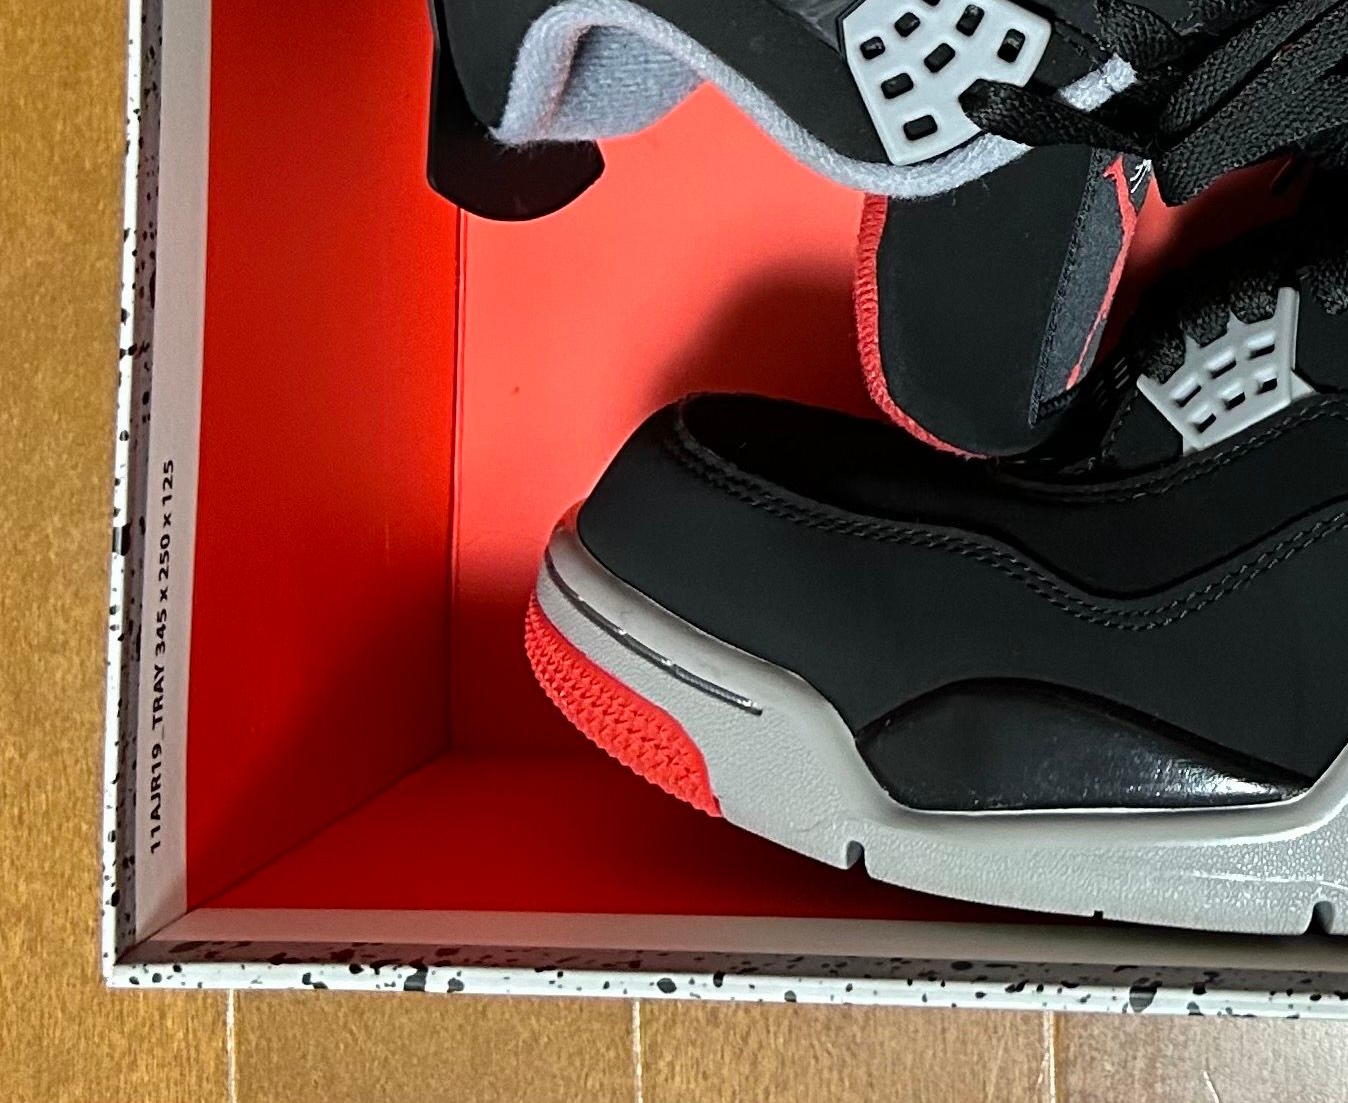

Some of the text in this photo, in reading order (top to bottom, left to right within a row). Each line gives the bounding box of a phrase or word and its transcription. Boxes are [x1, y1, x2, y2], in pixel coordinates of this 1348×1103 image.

[162, 459, 174, 507] 125
[163, 512, 172, 529] x
[158, 533, 171, 582] 250
[160, 587, 169, 603] x
[155, 608, 168, 656] 345
